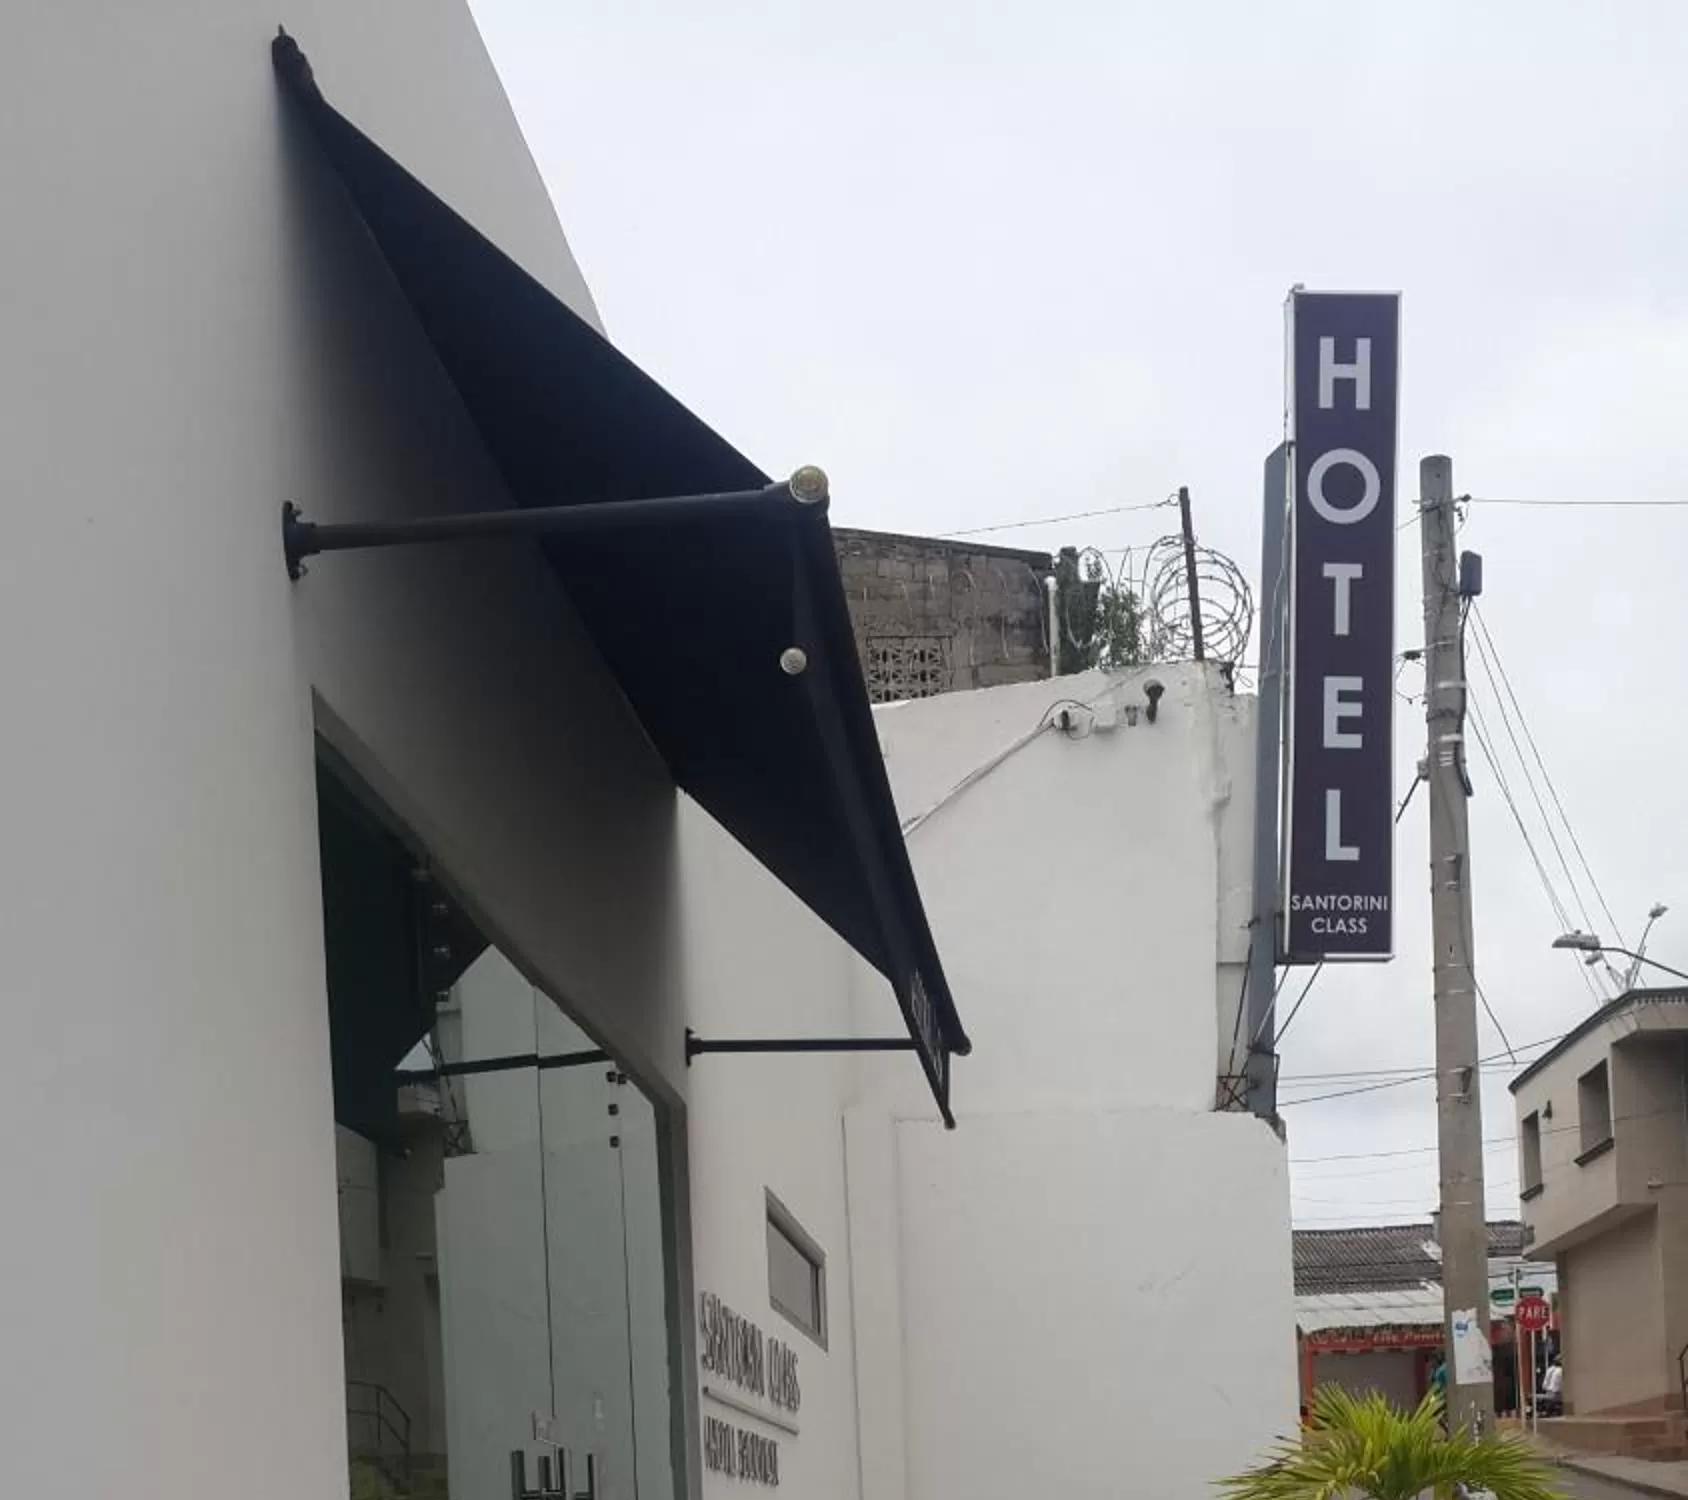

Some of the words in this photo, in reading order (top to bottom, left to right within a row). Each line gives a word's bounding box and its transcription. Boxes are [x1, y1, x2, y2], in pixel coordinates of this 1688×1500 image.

[1306, 335, 1381, 861] HOTEL
[1291, 893, 1388, 911] SANTORINI
[1311, 917, 1367, 934] CLASS
[1518, 1304, 1549, 1320] PARE
